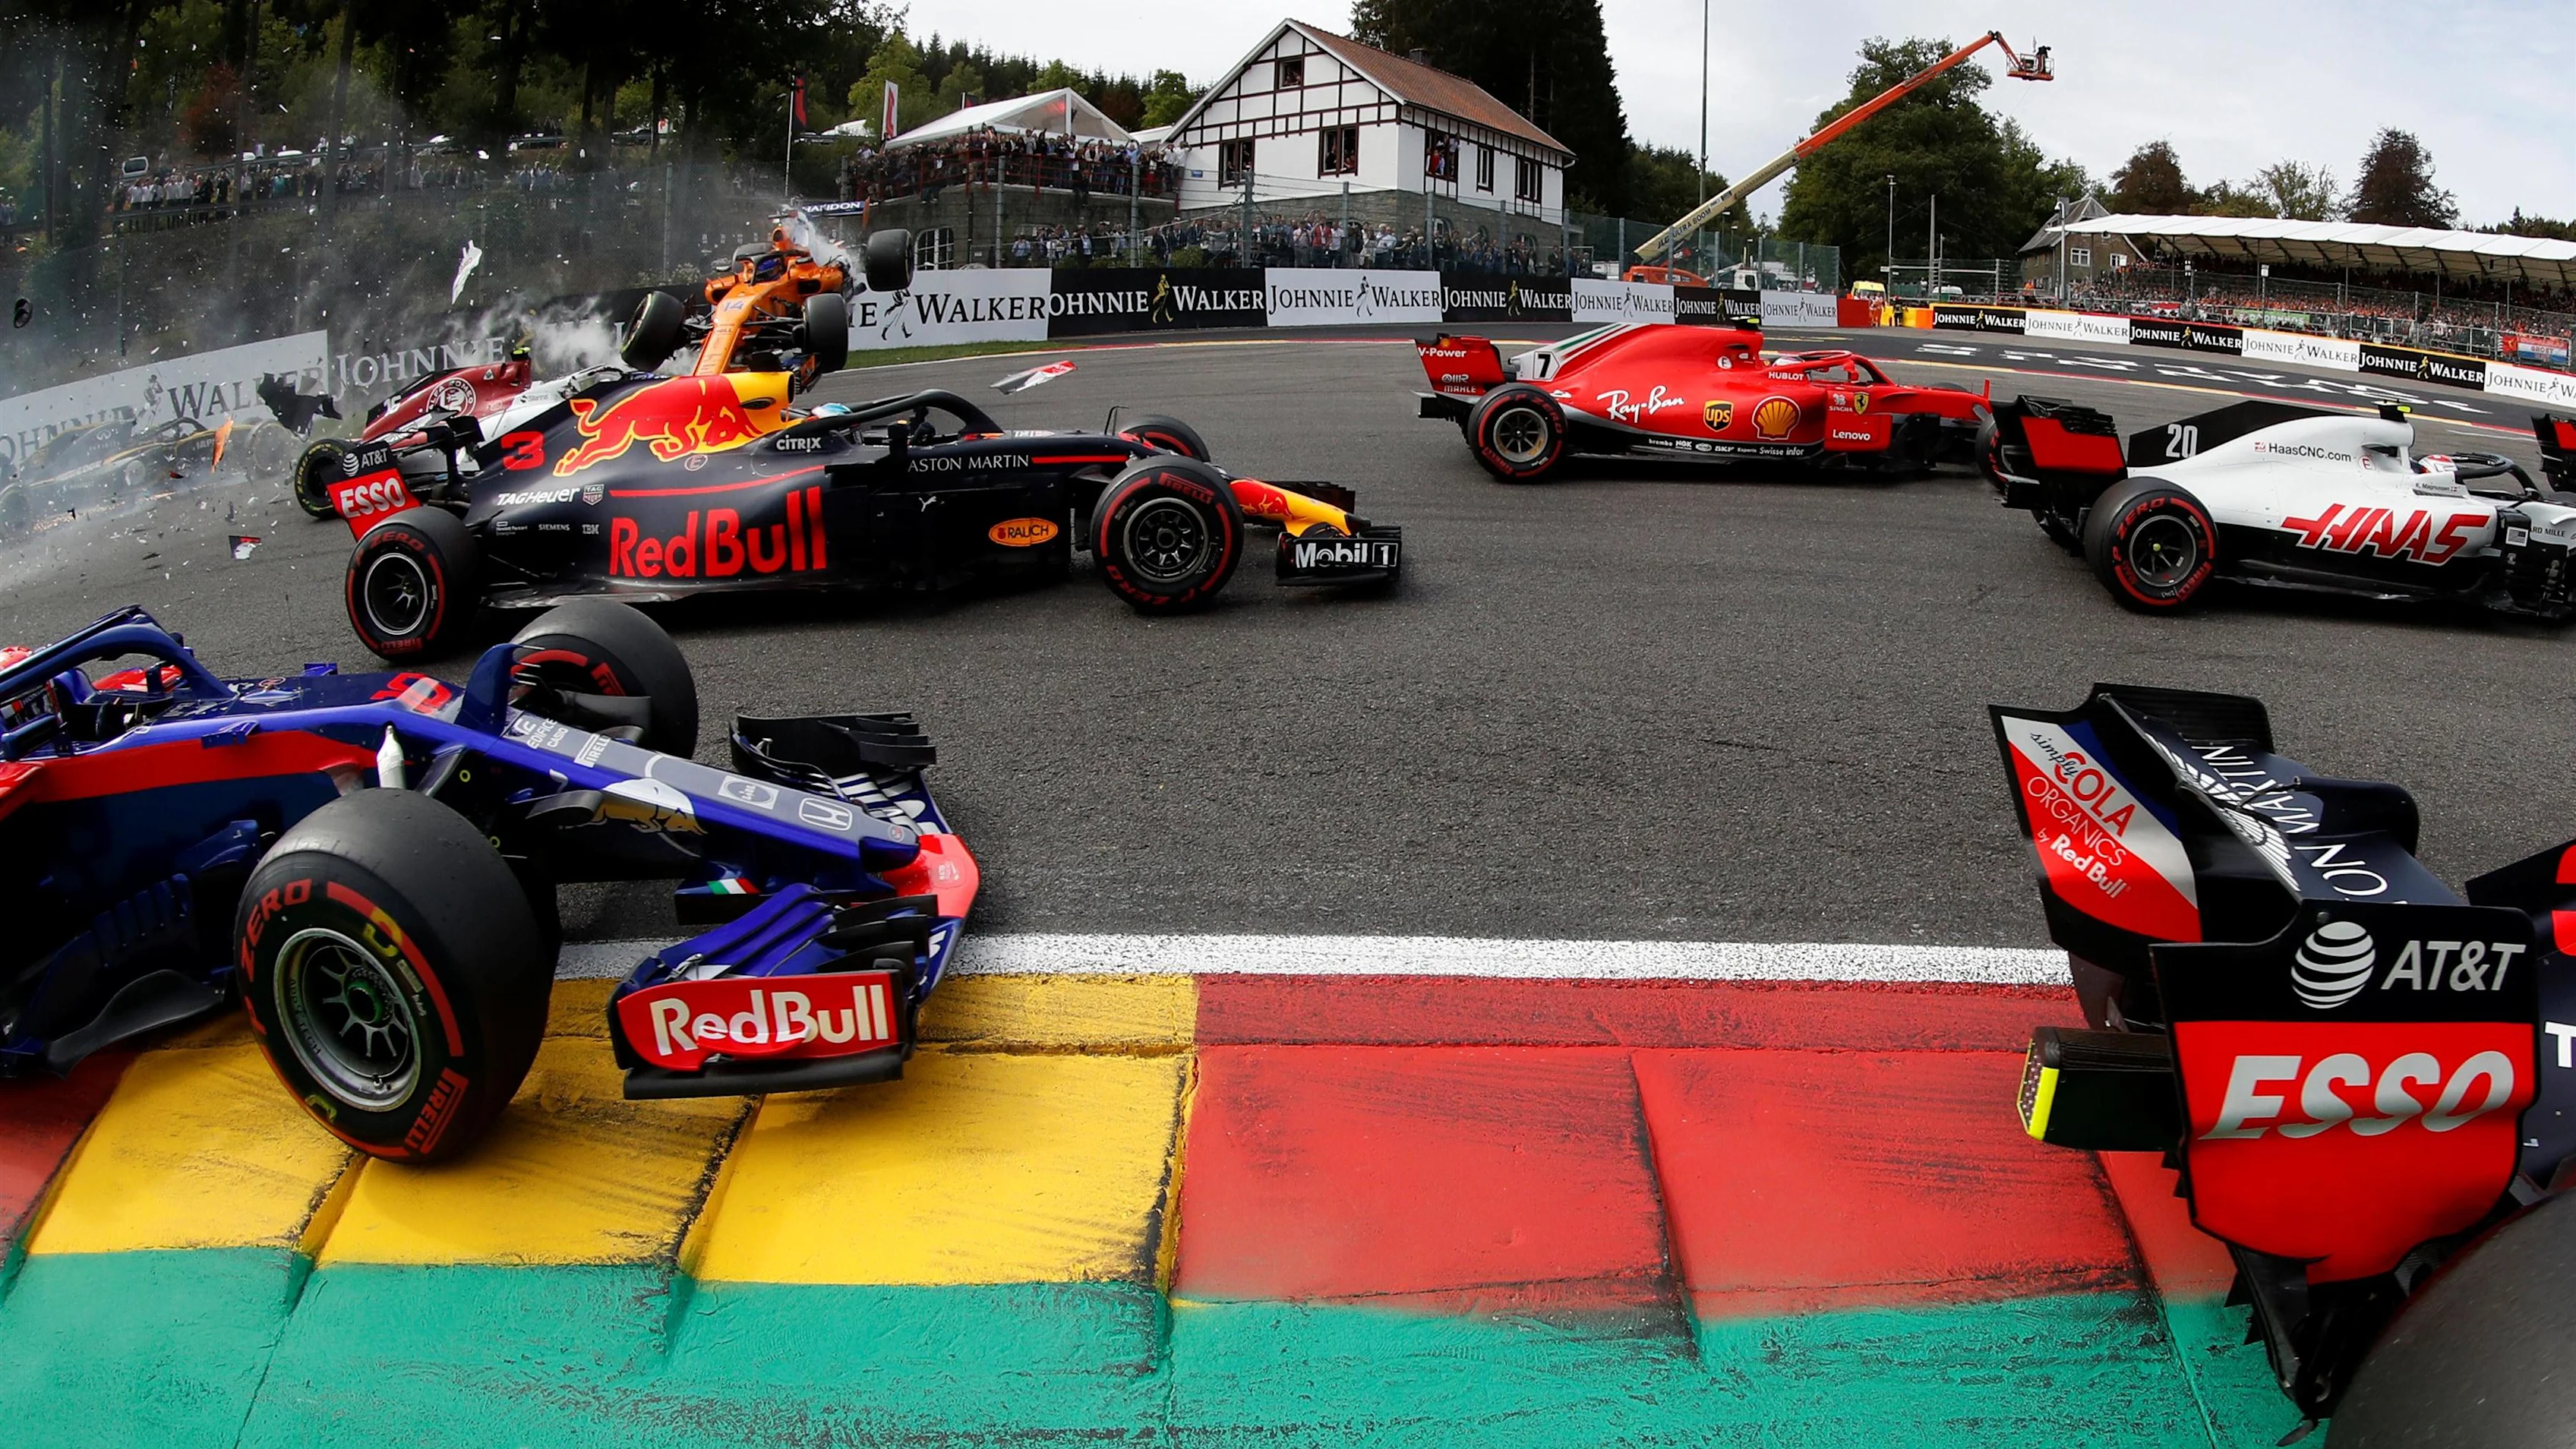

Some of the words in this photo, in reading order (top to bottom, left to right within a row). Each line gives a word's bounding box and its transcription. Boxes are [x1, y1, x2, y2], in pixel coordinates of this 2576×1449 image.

[724, 301, 743, 311] 14
[914, 293, 1046, 324] WALKER
[1049, 291, 1148, 317] OHNNIE
[1172, 286, 1265, 312] WALKER
[1269, 286, 1353, 314] JOHNNIE
[1372, 286, 1441, 308] WALKER
[1442, 286, 1507, 313] JOHNNIE
[1519, 289, 1572, 309] WALKER
[1573, 292, 1622, 314] JOHNNIE
[1633, 294, 1674, 312] WALKER
[1675, 297, 1716, 317] JOHNNIE
[1724, 299, 1761, 316] WALKER
[1762, 301, 1798, 318] JOHNNIE
[1805, 303, 1836, 317] WALKER
[1933, 312, 1975, 325] JOHNNIE
[1984, 314, 2025, 328] WALKER
[2025, 319, 2073, 332] JOHNNIE
[2083, 324, 2128, 336] WALKER
[2129, 326, 2180, 342] JOHNNIE
[2192, 333, 2242, 349] WALKER
[1418, 346, 1467, 358] V-Power
[2243, 341, 2293, 355] JOHNNIE
[2306, 346, 2358, 363] WALKER
[1537, 353, 1551, 378] 7
[1768, 371, 1804, 381] HUBLOT
[2360, 352, 2417, 372] JOHNNIE
[2429, 362, 2484, 383] WALKER
[1444, 385, 1476, 393] MAHLE
[2486, 371, 2546, 393] JOHNNIE
[383, 393, 402, 415] 16
[1596, 385, 1684, 424] Ray-Ban
[1706, 408, 1731, 427] ups
[1649, 438, 1673, 447] brembo
[1833, 429, 1871, 441] Lenovo
[2165, 423, 2198, 458] 20
[361, 448, 388, 469] AT&T
[500, 431, 545, 472] 3
[1759, 447, 1784, 456] Swisse
[1785, 447, 1805, 456] infor
[2268, 443, 2352, 462] HaasCNC.com
[908, 457, 962, 472] ASTON
[968, 455, 1030, 469] MARTIN
[339, 478, 406, 519] ESSO
[1158, 472, 1215, 504] PIRELLI
[582, 524, 600, 535] IBM
[2117, 497, 2166, 540] ZERO
[370, 531, 425, 551] ZERO
[1007, 524, 1050, 540] RAUCH
[2280, 503, 2491, 567] HAAS
[2545, 528, 2566, 538] MILLE
[1295, 542, 1368, 569] Mobil
[526, 718, 558, 750] EDIFICE
[547, 728, 569, 748] CASIO
[2030, 732, 2079, 777] simply
[2054, 751, 2136, 838] COLA
[2027, 776, 2127, 867] ORGANICS
[2037, 827, 2050, 843] by
[240, 878, 313, 983] ZERO
[2380, 939, 2527, 992] AT&T
[2198, 1050, 2516, 1141] ESSO
[405, 1066, 470, 1155] PIRELLI
